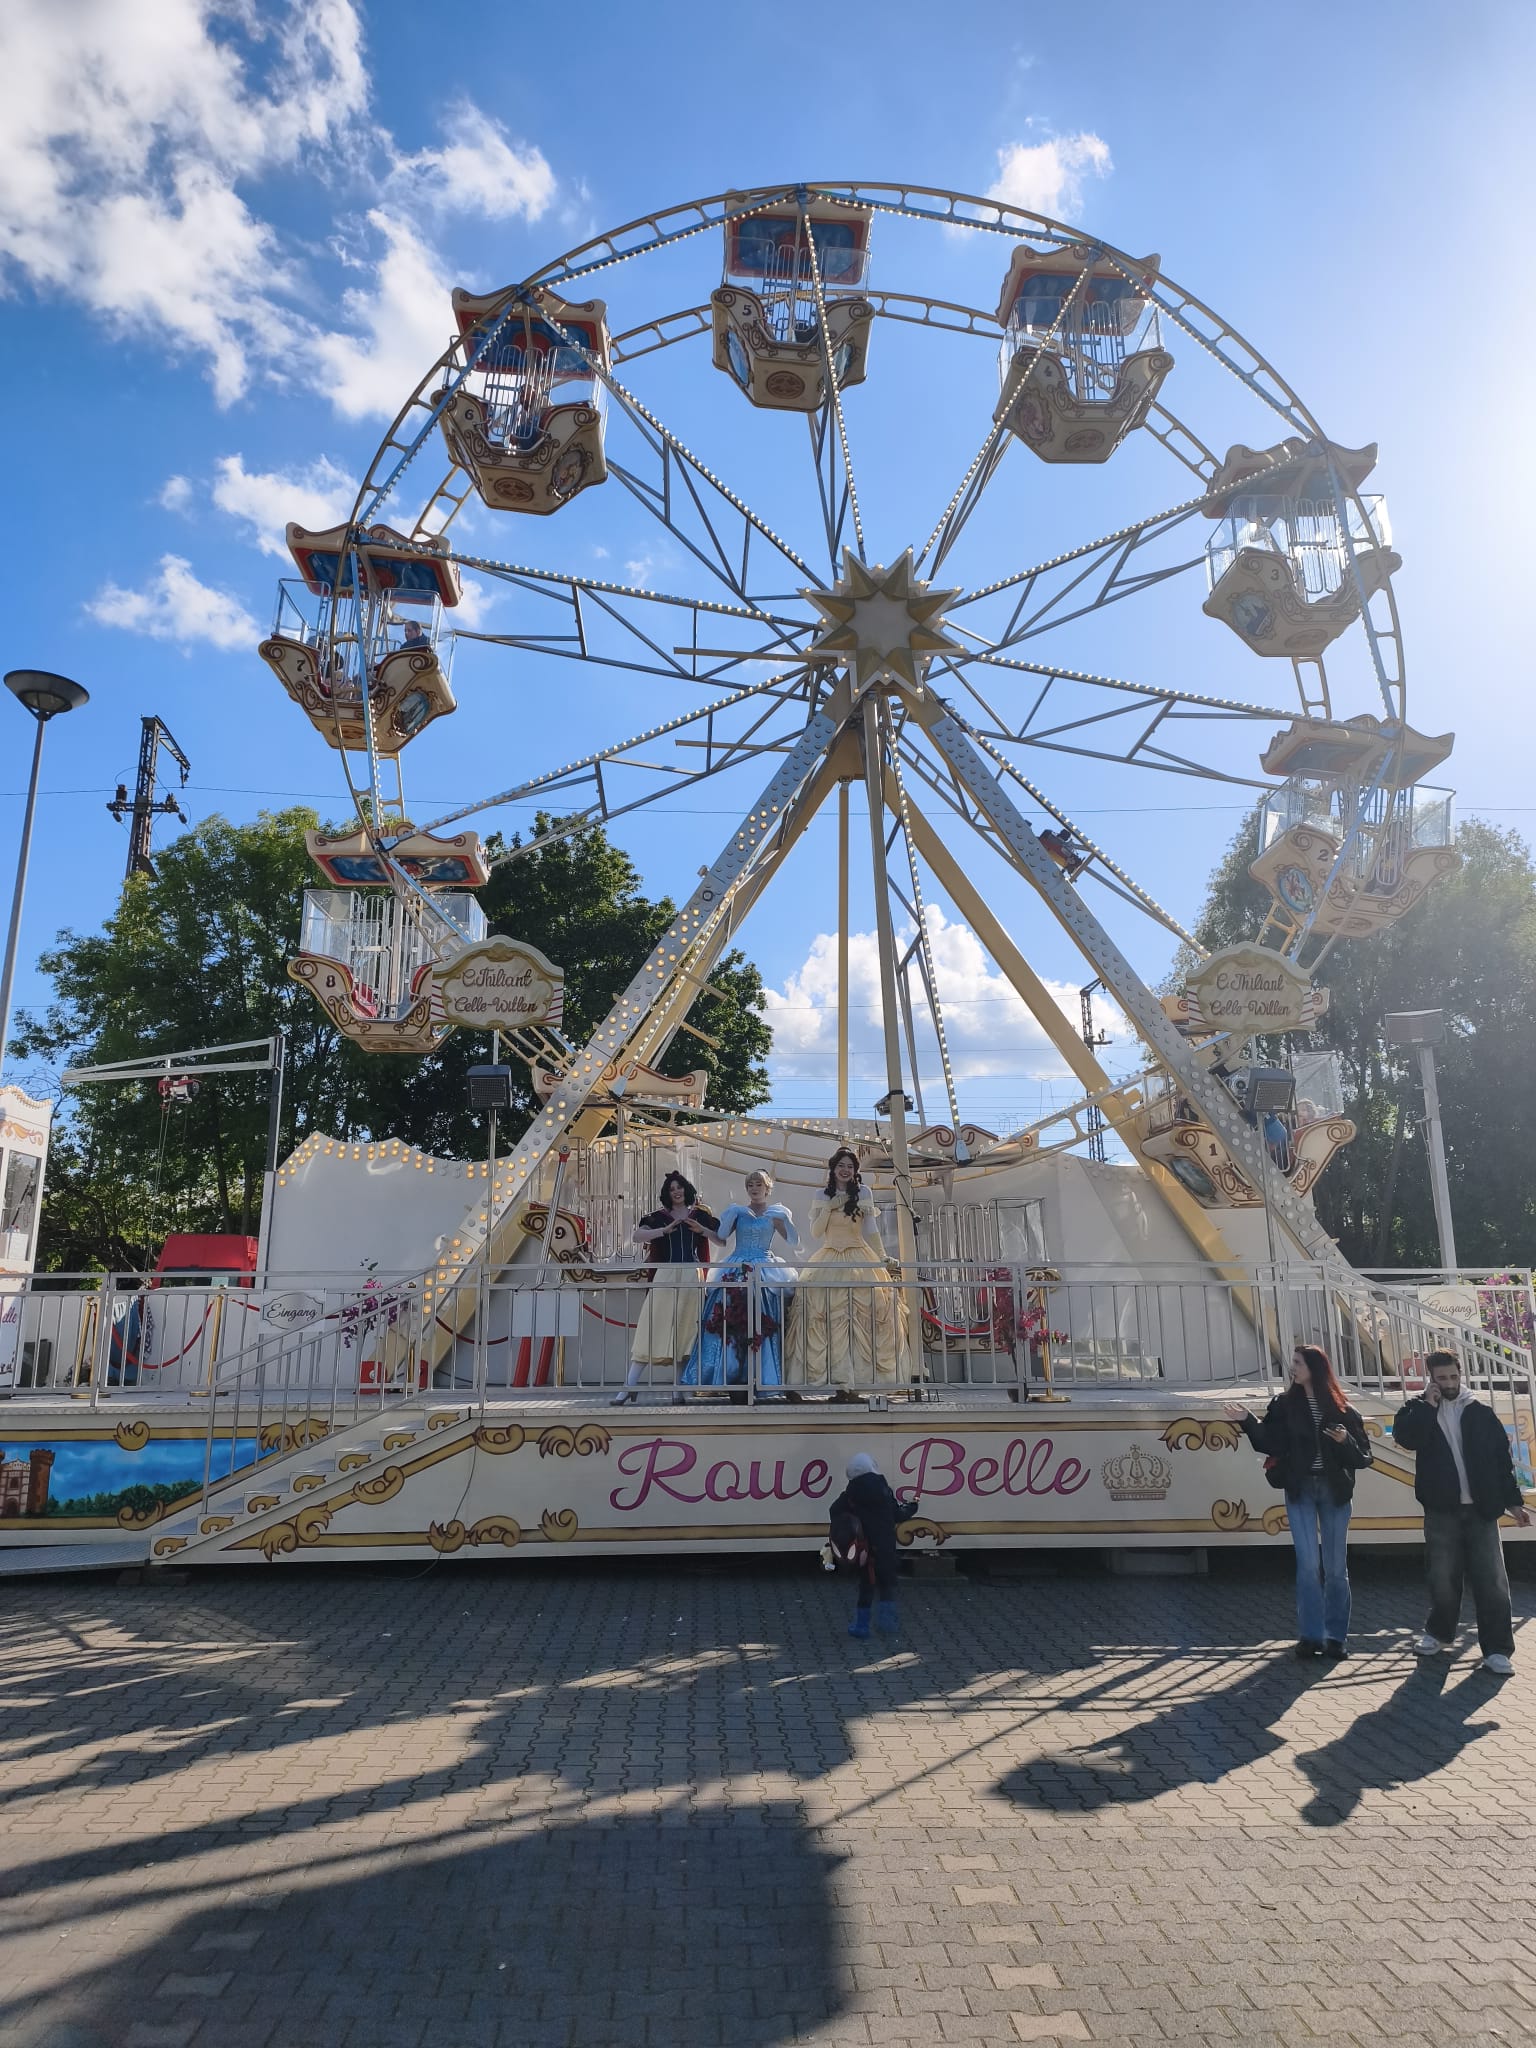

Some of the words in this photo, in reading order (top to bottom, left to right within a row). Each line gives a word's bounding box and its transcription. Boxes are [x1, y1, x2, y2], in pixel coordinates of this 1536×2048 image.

[742, 305, 752, 316] 5
[1044, 366, 1053, 377] 4
[465, 409, 474, 420] 6
[1270, 569, 1279, 580] 3
[296, 659, 306, 672] 7
[1318, 849, 1329, 862] 2
[326, 975, 337, 988] 8
[1209, 1143, 1218, 1157] 1
[555, 1226, 566, 1239] 9
[266, 1303, 317, 1322] Eingang
[609, 1437, 833, 1511] Roue
[895, 1437, 1091, 1502] Belle
